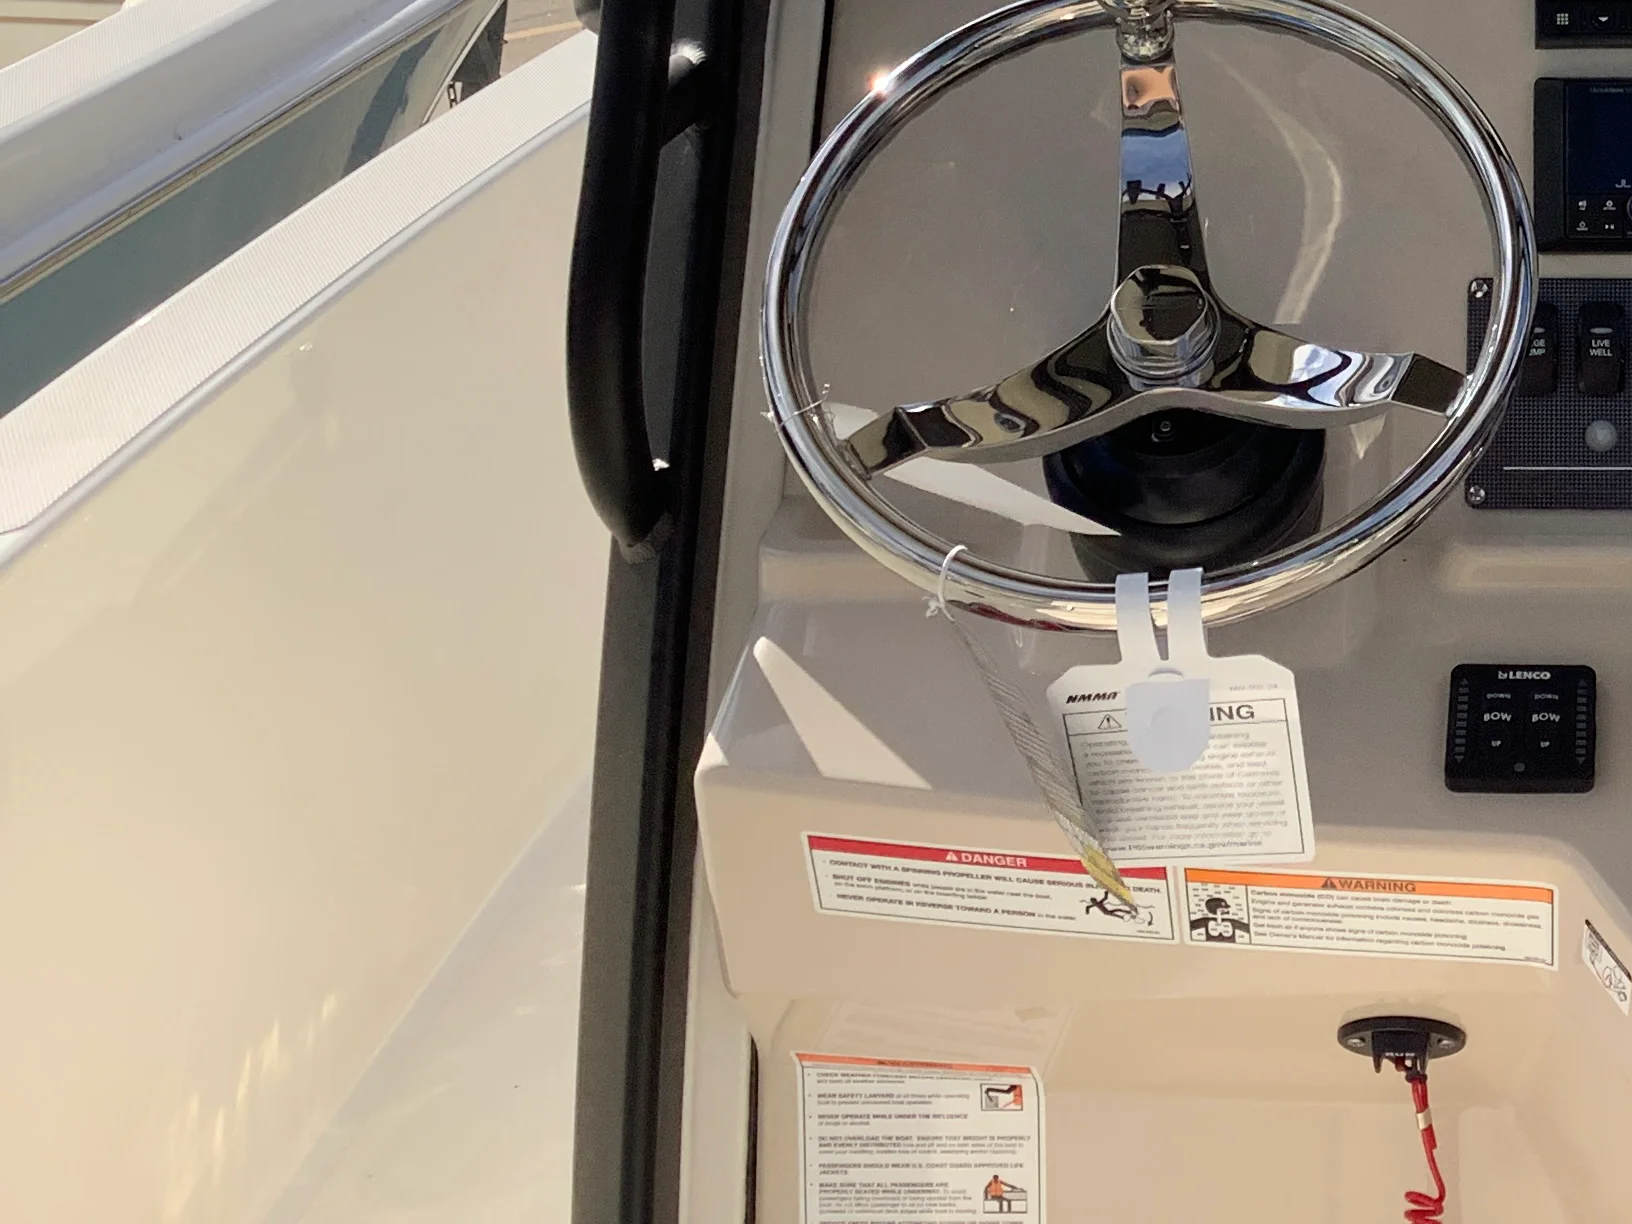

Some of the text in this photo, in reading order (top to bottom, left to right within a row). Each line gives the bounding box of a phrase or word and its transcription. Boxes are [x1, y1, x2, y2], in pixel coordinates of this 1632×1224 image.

[1615, 179, 1632, 188] JL
[1591, 339, 1611, 348] LIVE
[1589, 348, 1613, 357] WELL
[1508, 670, 1552, 680] LENCO
[1483, 711, 1512, 722] BOW
[1532, 712, 1560, 723] BOW
[962, 853, 1027, 867] DANGER
[830, 860, 868, 868] CONTACT
[901, 867, 940, 876] SPINNING
[943, 871, 992, 881] PROPELLER
[993, 875, 1015, 883] WILL
[1047, 880, 1083, 888] SERIOUS
[874, 878, 910, 887] ENGINES
[1338, 879, 1417, 892] WARNING
[866, 896, 903, 905] OPERATE
[916, 901, 953, 910] REVERSE
[956, 904, 992, 913] TOWARD
[1002, 909, 1036, 917] PERSON
